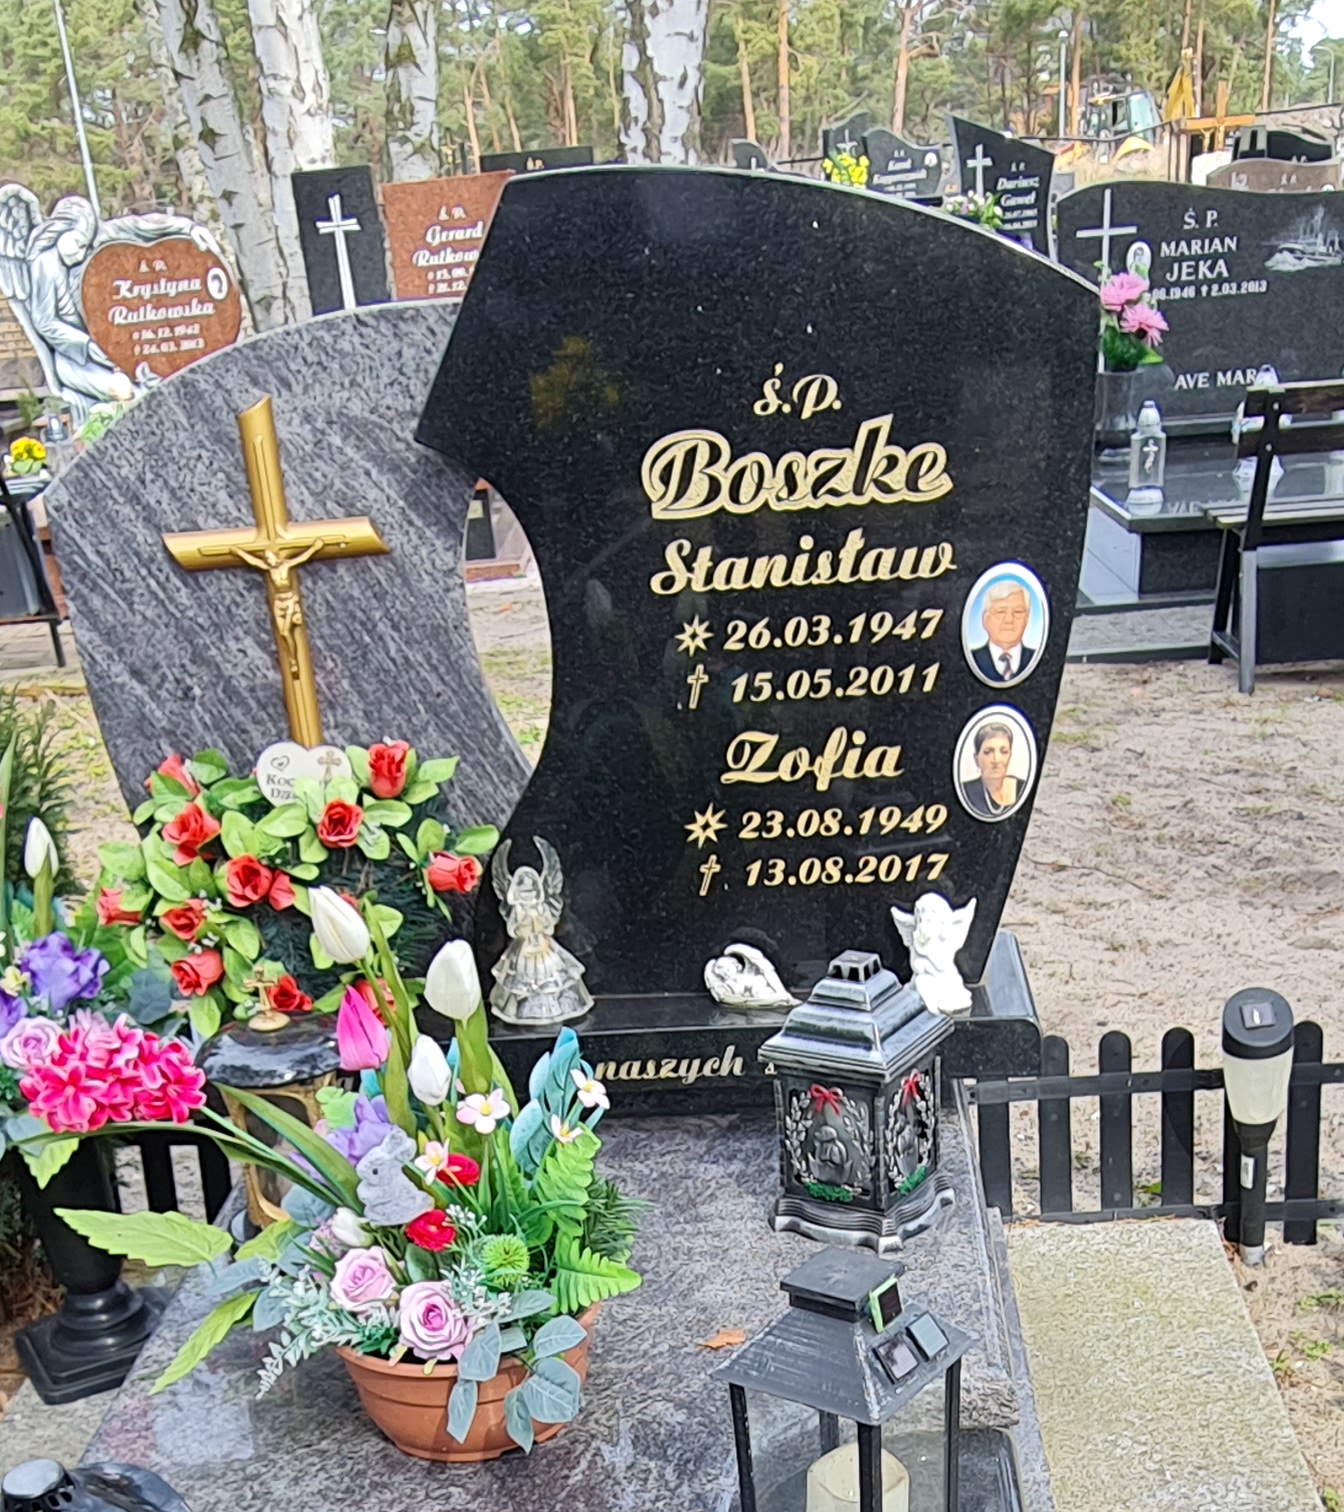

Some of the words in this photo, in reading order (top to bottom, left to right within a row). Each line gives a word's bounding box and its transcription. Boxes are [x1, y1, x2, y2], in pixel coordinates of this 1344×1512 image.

[425, 220, 484, 247] Gerard
[1160, 235, 1239, 258] MARIAN
[1165, 258, 1230, 283] JEKA
[112, 277, 202, 301] Krystyna
[107, 297, 216, 326] Rutkowska
[1173, 372, 1210, 391] AVE
[641, 413, 954, 520] Boszke
[650, 527, 957, 595] Stanisław
[722, 608, 944, 650] 26.03.1947
[730, 662, 941, 702] 15.05.2011
[719, 726, 905, 791] Zofia
[737, 804, 948, 839] 23.08.1949
[745, 853, 949, 887] 13.08.2017
[594, 1045, 745, 1085] naszych
